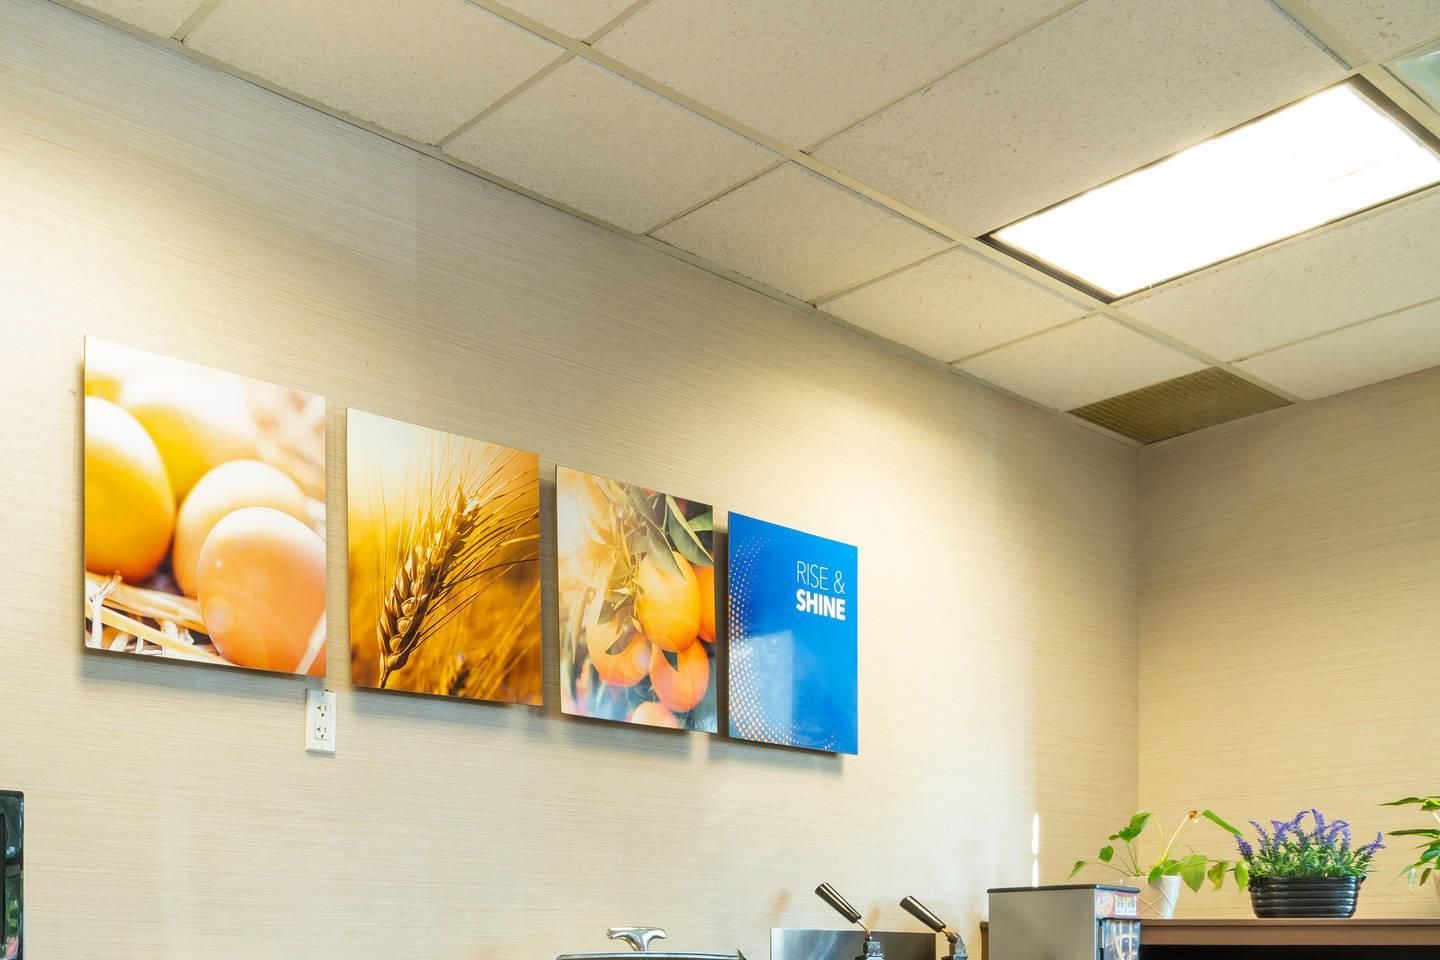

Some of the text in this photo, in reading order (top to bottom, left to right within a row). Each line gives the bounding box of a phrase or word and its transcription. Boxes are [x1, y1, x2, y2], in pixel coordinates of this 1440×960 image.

[796, 560, 846, 595] RISE &
[795, 588, 846, 621] SHINE
